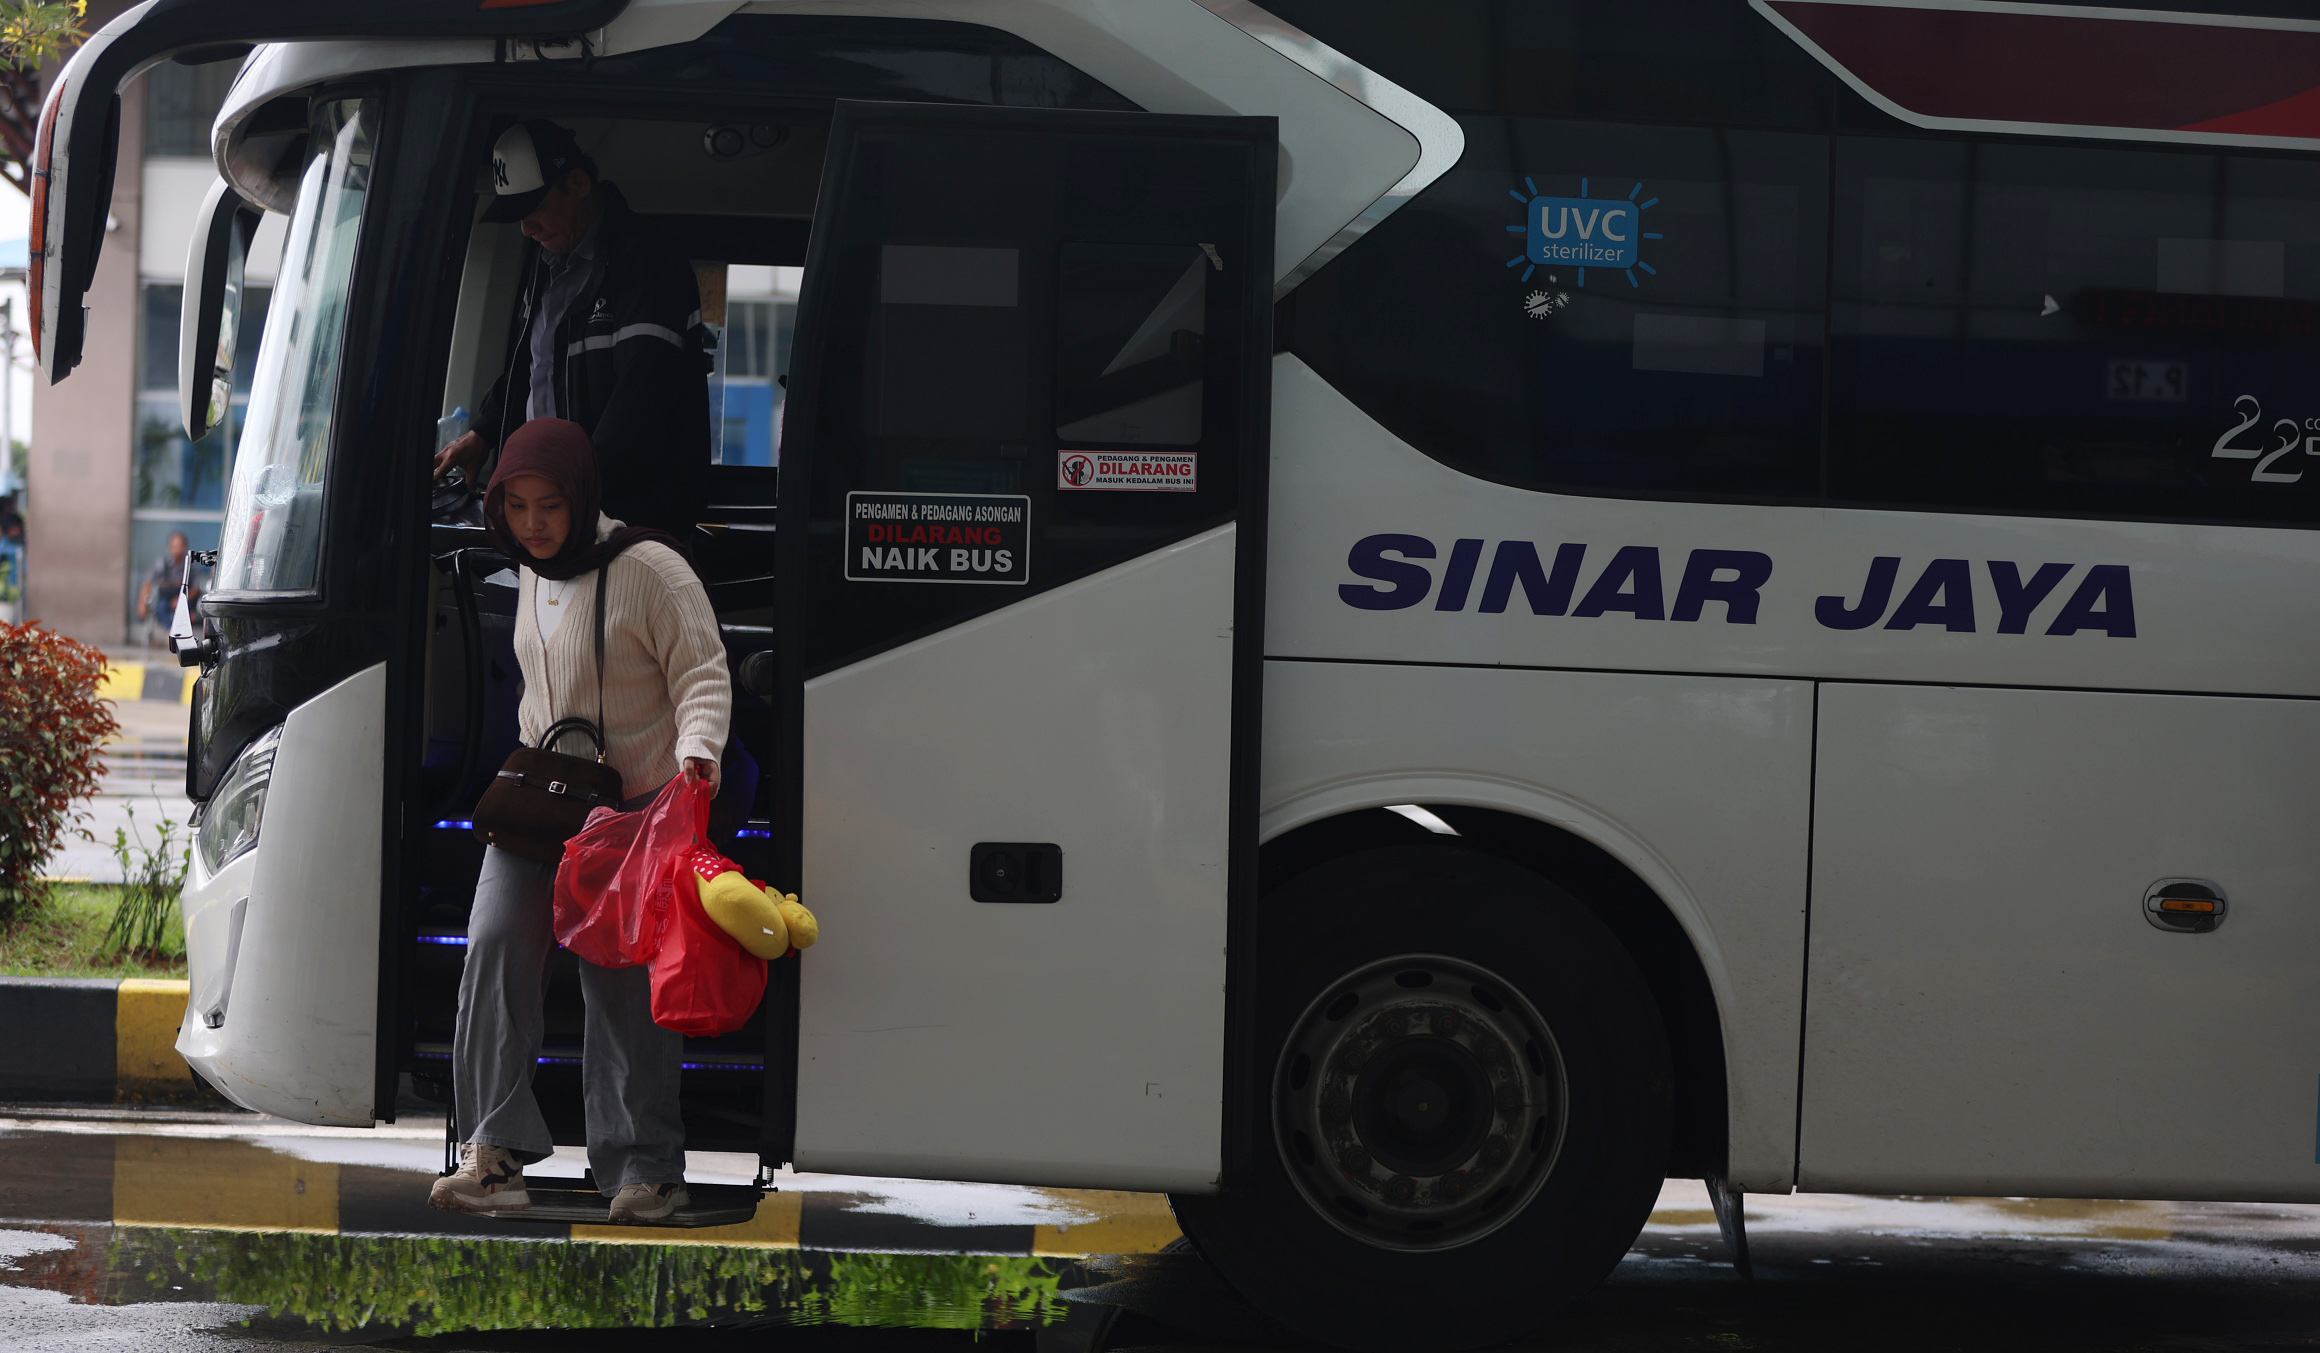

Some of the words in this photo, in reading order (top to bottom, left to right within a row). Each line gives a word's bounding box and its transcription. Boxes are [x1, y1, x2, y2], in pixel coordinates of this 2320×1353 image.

[1541, 206, 1627, 242] UVC
[1543, 243, 1624, 261] sterilizer
[1099, 462, 1191, 476] DILARANG
[1126, 477, 1163, 485] KEDALAM
[856, 503, 909, 520] PENGAMEN
[911, 504, 918, 520] &
[921, 505, 972, 521] PEDAGANG
[974, 506, 1021, 523] ASONGAN
[868, 524, 1003, 546] DILARANG
[862, 546, 940, 571] NAIK
[950, 548, 1013, 573] BUS
[1338, 533, 1773, 625] SINAR
[1814, 556, 2137, 638] JAYA
